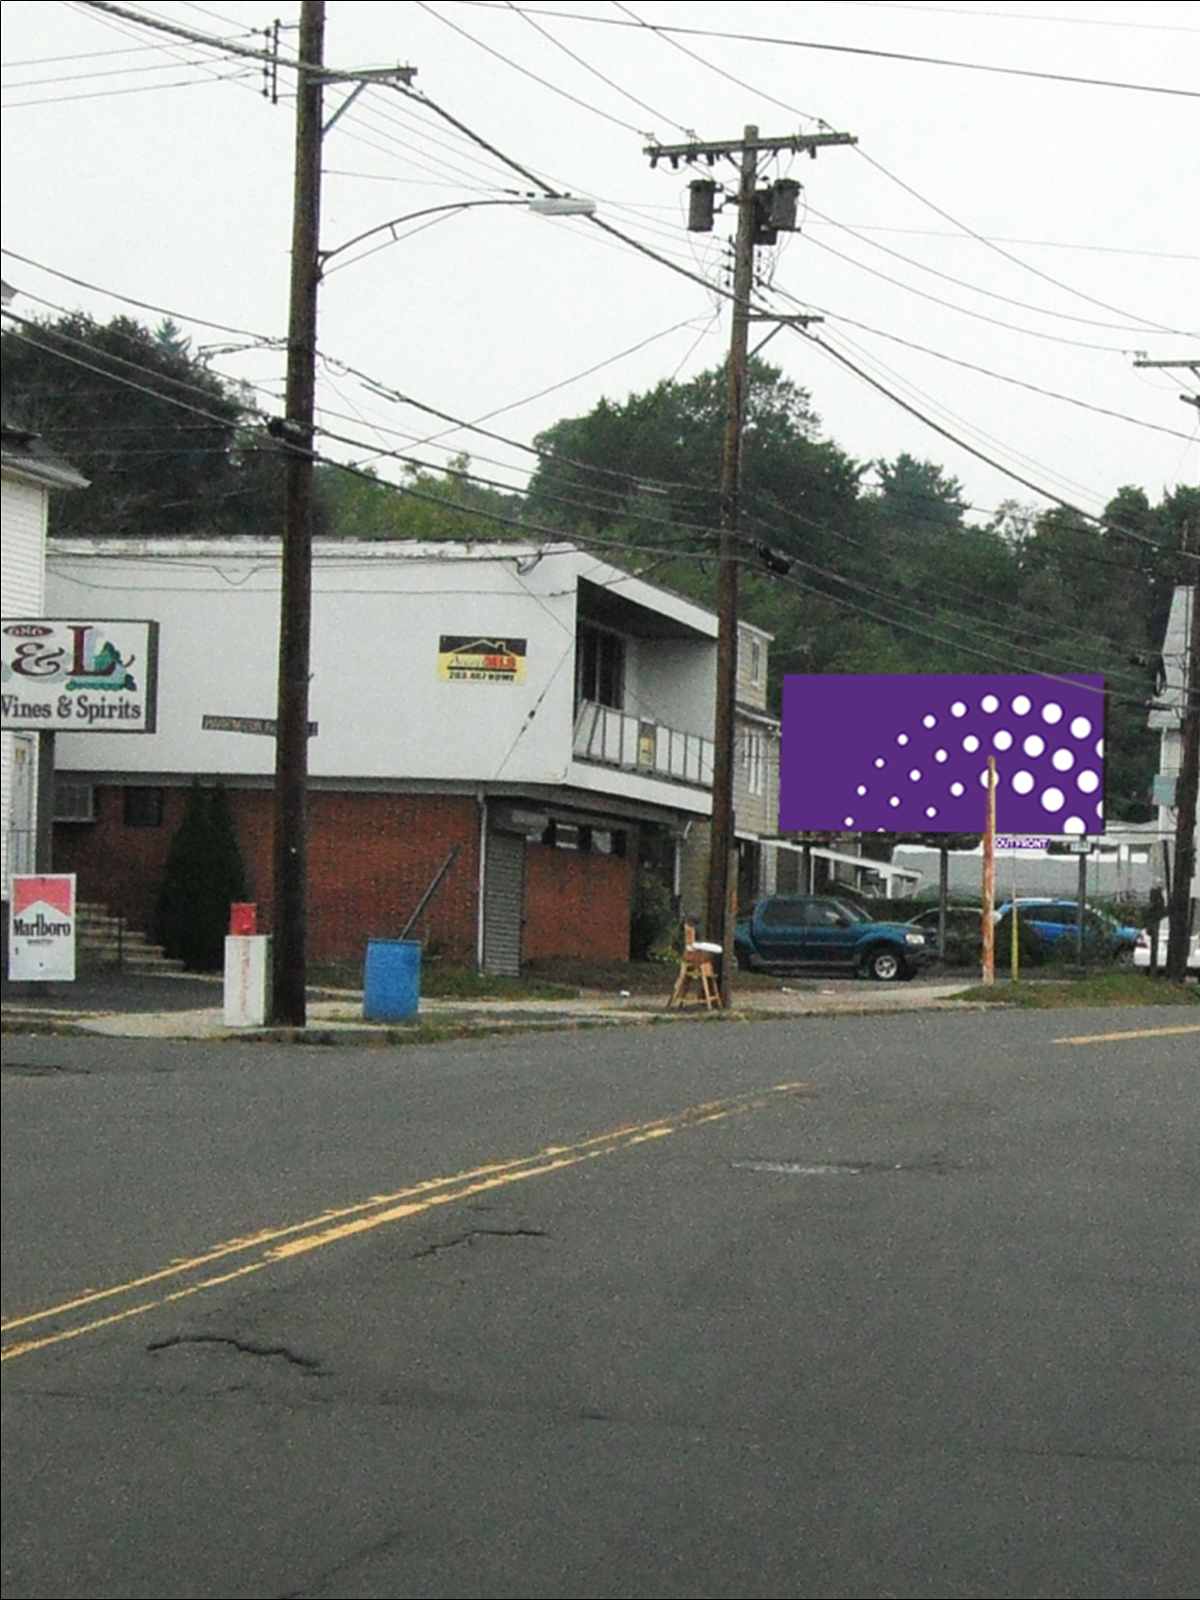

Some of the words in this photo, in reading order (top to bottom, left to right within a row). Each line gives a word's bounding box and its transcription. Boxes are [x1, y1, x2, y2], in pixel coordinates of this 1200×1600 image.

[11, 642, 65, 676] &
[66, 625, 117, 676] L
[57, 694, 73, 719] &
[76, 694, 141, 725] Spirits
[995, 837, 1048, 849] OUTFRONT
[14, 913, 71, 937] Marlboro
